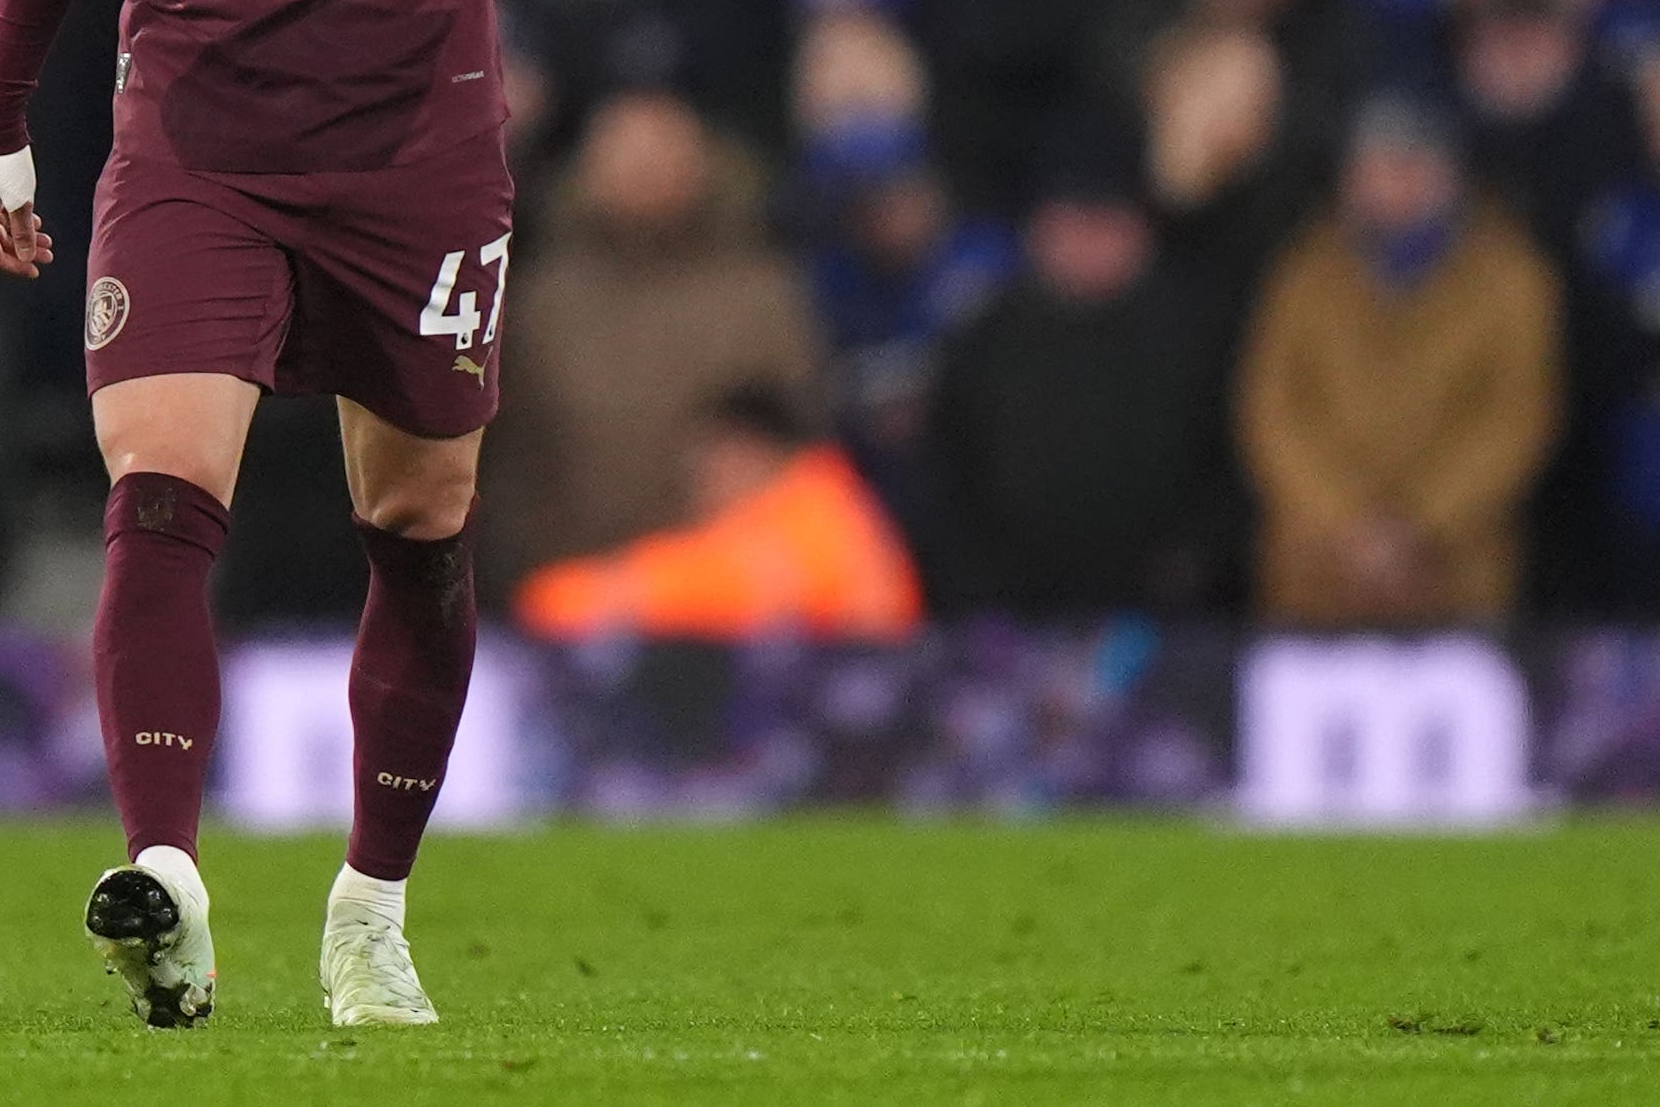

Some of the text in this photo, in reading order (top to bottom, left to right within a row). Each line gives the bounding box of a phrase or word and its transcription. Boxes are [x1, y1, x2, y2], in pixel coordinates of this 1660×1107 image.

[419, 230, 513, 351] 47
[134, 730, 193, 751] CITY
[376, 771, 437, 792] CITY
